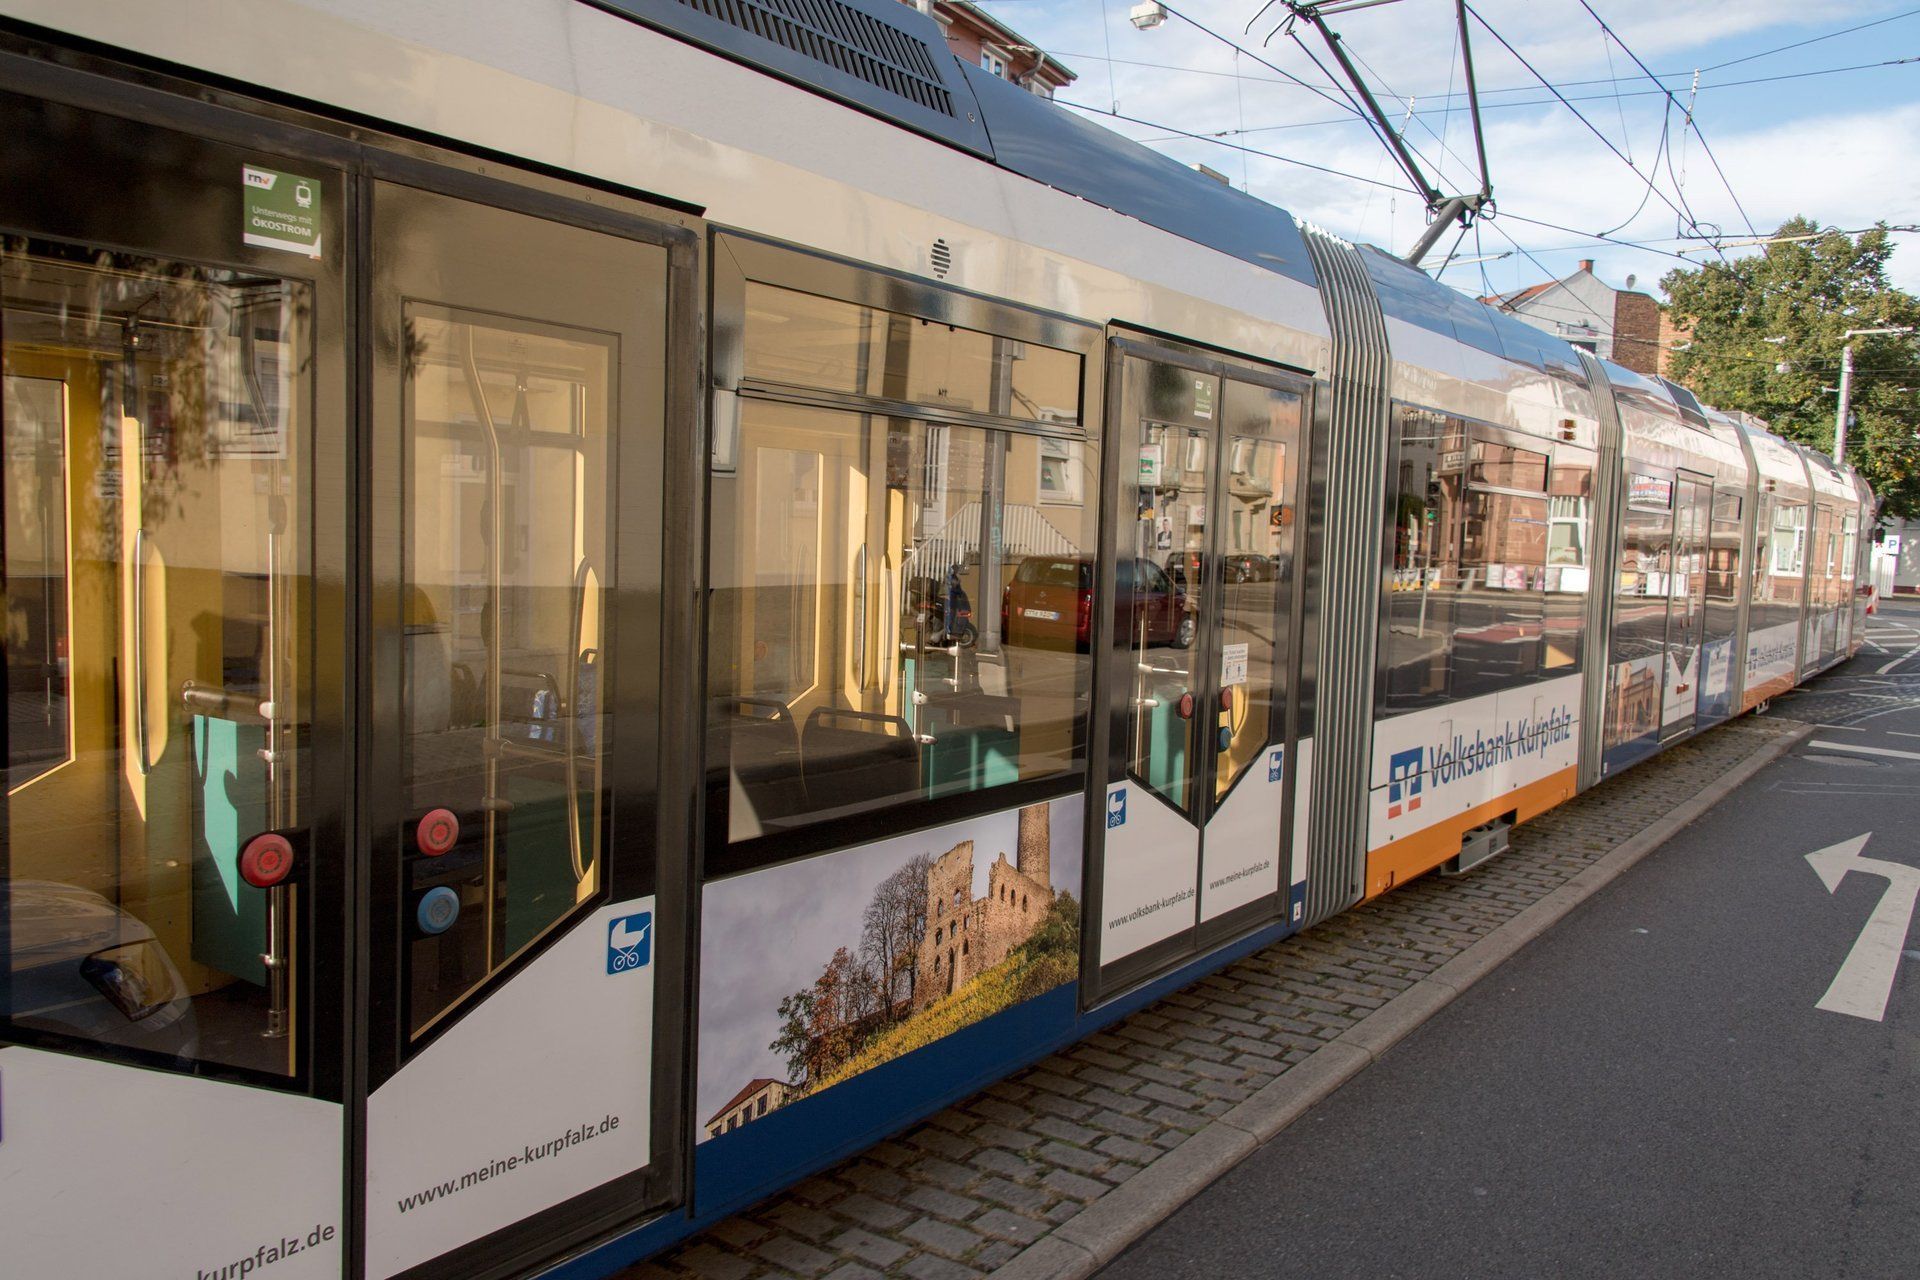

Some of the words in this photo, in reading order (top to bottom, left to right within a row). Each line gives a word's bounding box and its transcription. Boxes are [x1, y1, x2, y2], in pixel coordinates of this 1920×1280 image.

[252, 205, 298, 223] Unterwegs
[298, 216, 313, 226] mit
[252, 216, 312, 237] ÖKOSTROM
[1888, 539, 1898, 549] P
[1429, 720, 1513, 788] Volksbank
[1517, 704, 1572, 760] Kurpfalz
[1208, 859, 1270, 891] www.meine-kurpfalz.de
[1108, 887, 1195, 930] www.volksbank-kurpfalz.de
[398, 1114, 620, 1214] www.meine-kurpfalz.de
